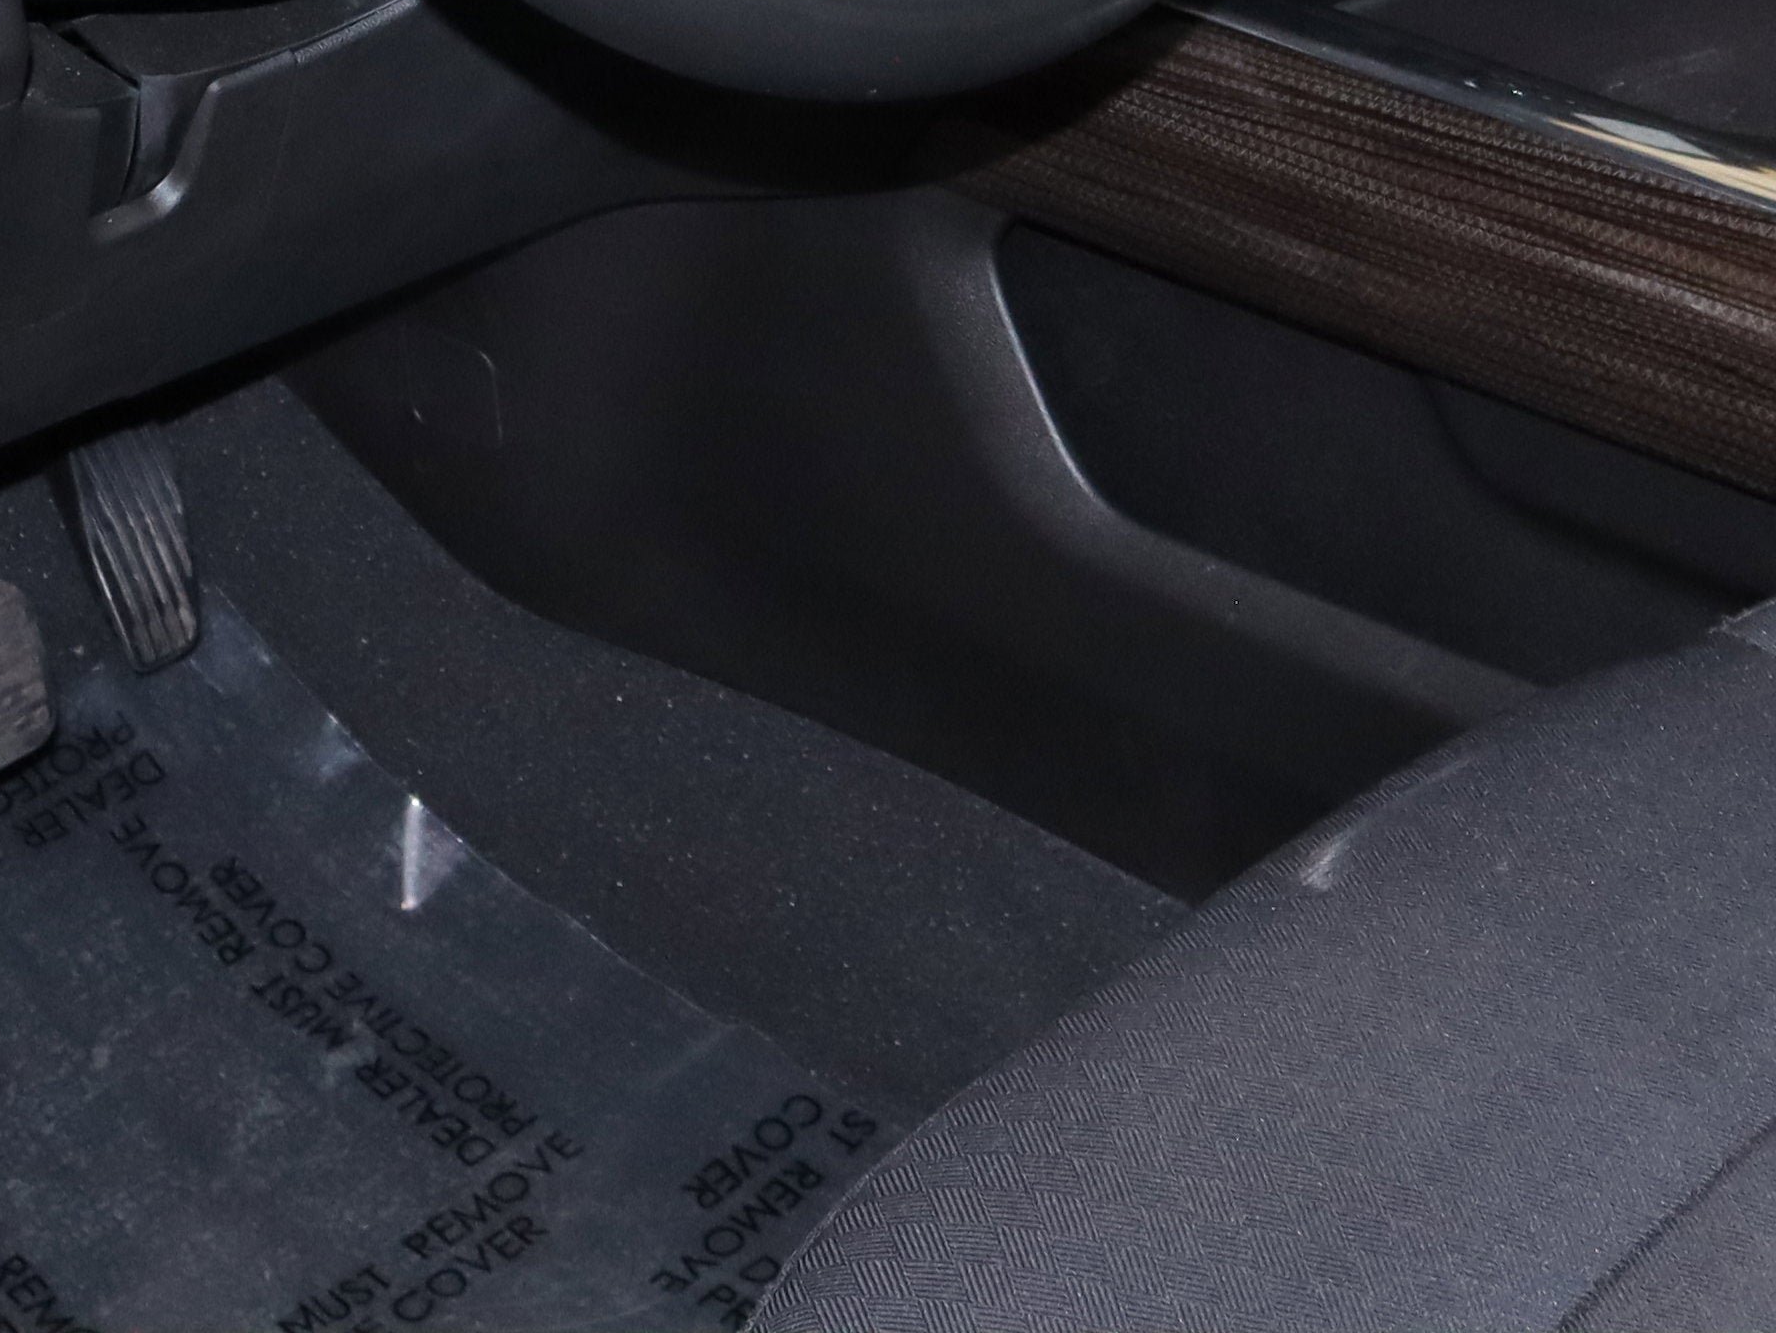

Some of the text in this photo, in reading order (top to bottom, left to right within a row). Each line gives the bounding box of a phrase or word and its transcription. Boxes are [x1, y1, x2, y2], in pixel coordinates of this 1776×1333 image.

[13, 748, 167, 848] DEALER
[109, 814, 497, 1167] DEALER MUST REMOVE
[209, 856, 539, 1139] PROTECTIVE COVER
[679, 1092, 824, 1210] COVER
[276, 1128, 585, 1333] MUST REMOVE
[391, 1214, 550, 1323] COVER
[648, 1158, 827, 1293] REMOVE
